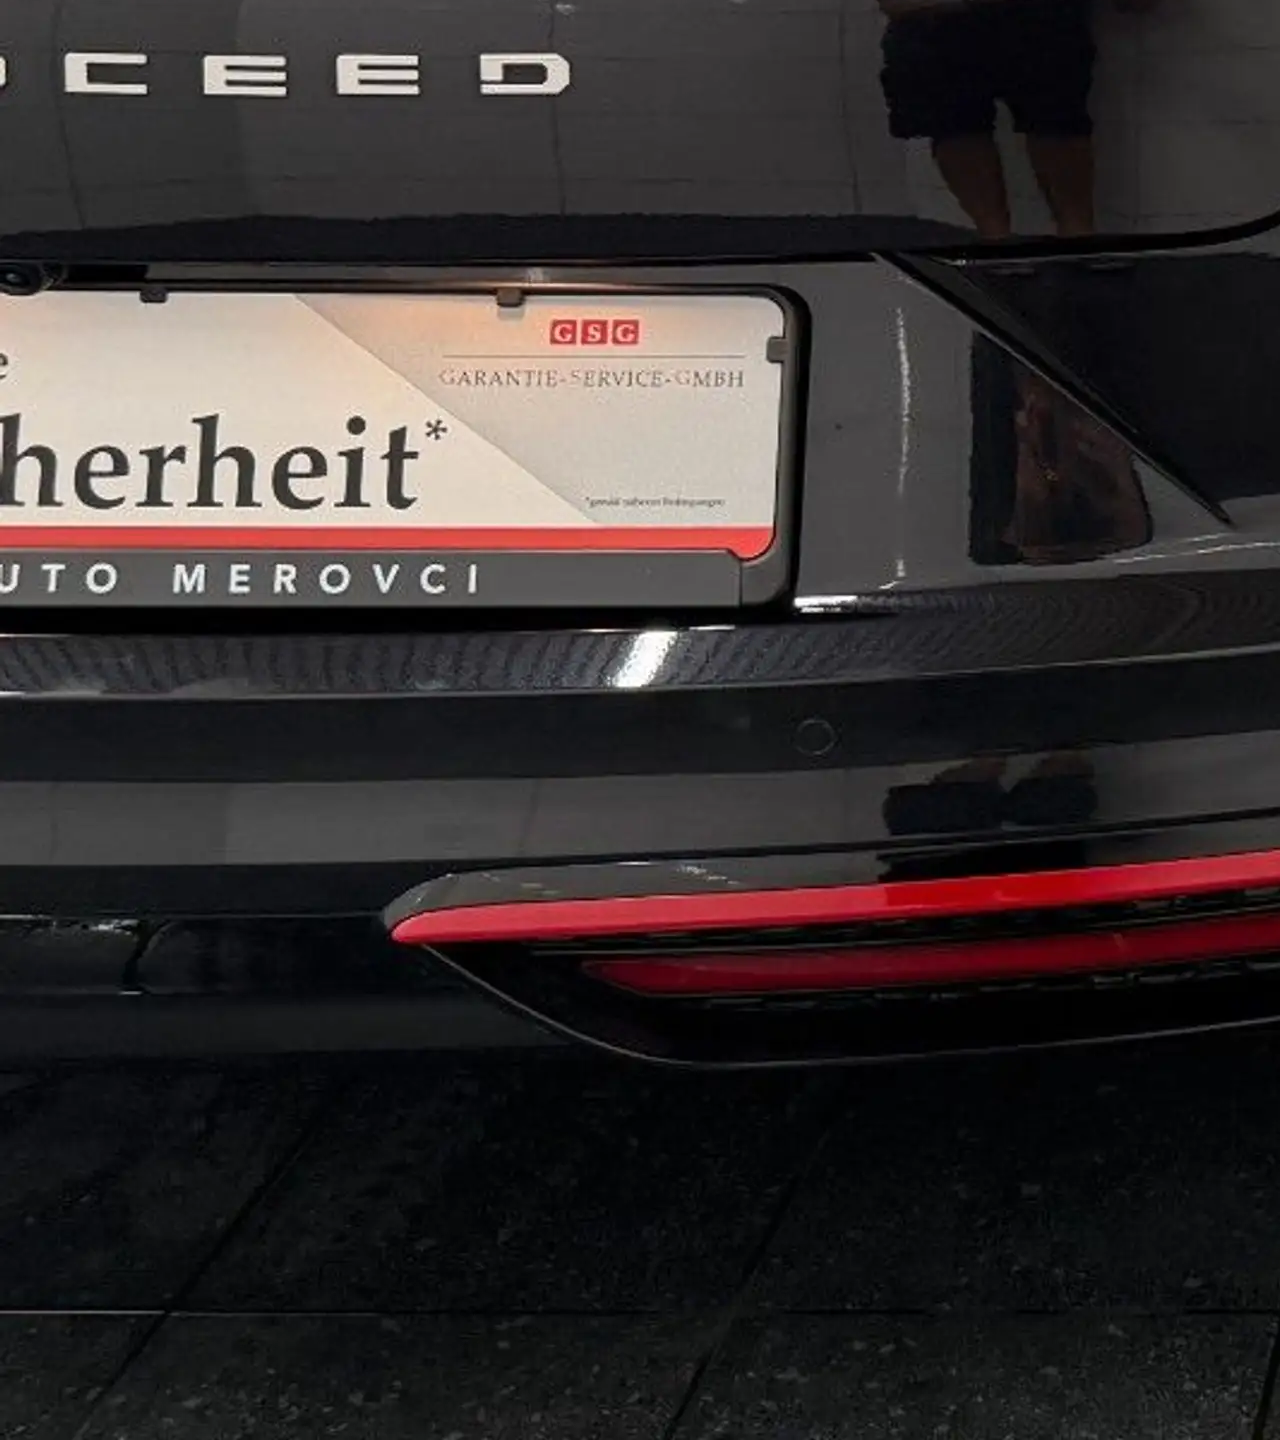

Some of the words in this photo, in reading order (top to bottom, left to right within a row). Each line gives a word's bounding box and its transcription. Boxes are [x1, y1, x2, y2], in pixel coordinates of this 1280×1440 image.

[0, 52, 571, 96] CEED
[551, 321, 638, 344] GSG
[172, 563, 478, 594] MEROVCI
